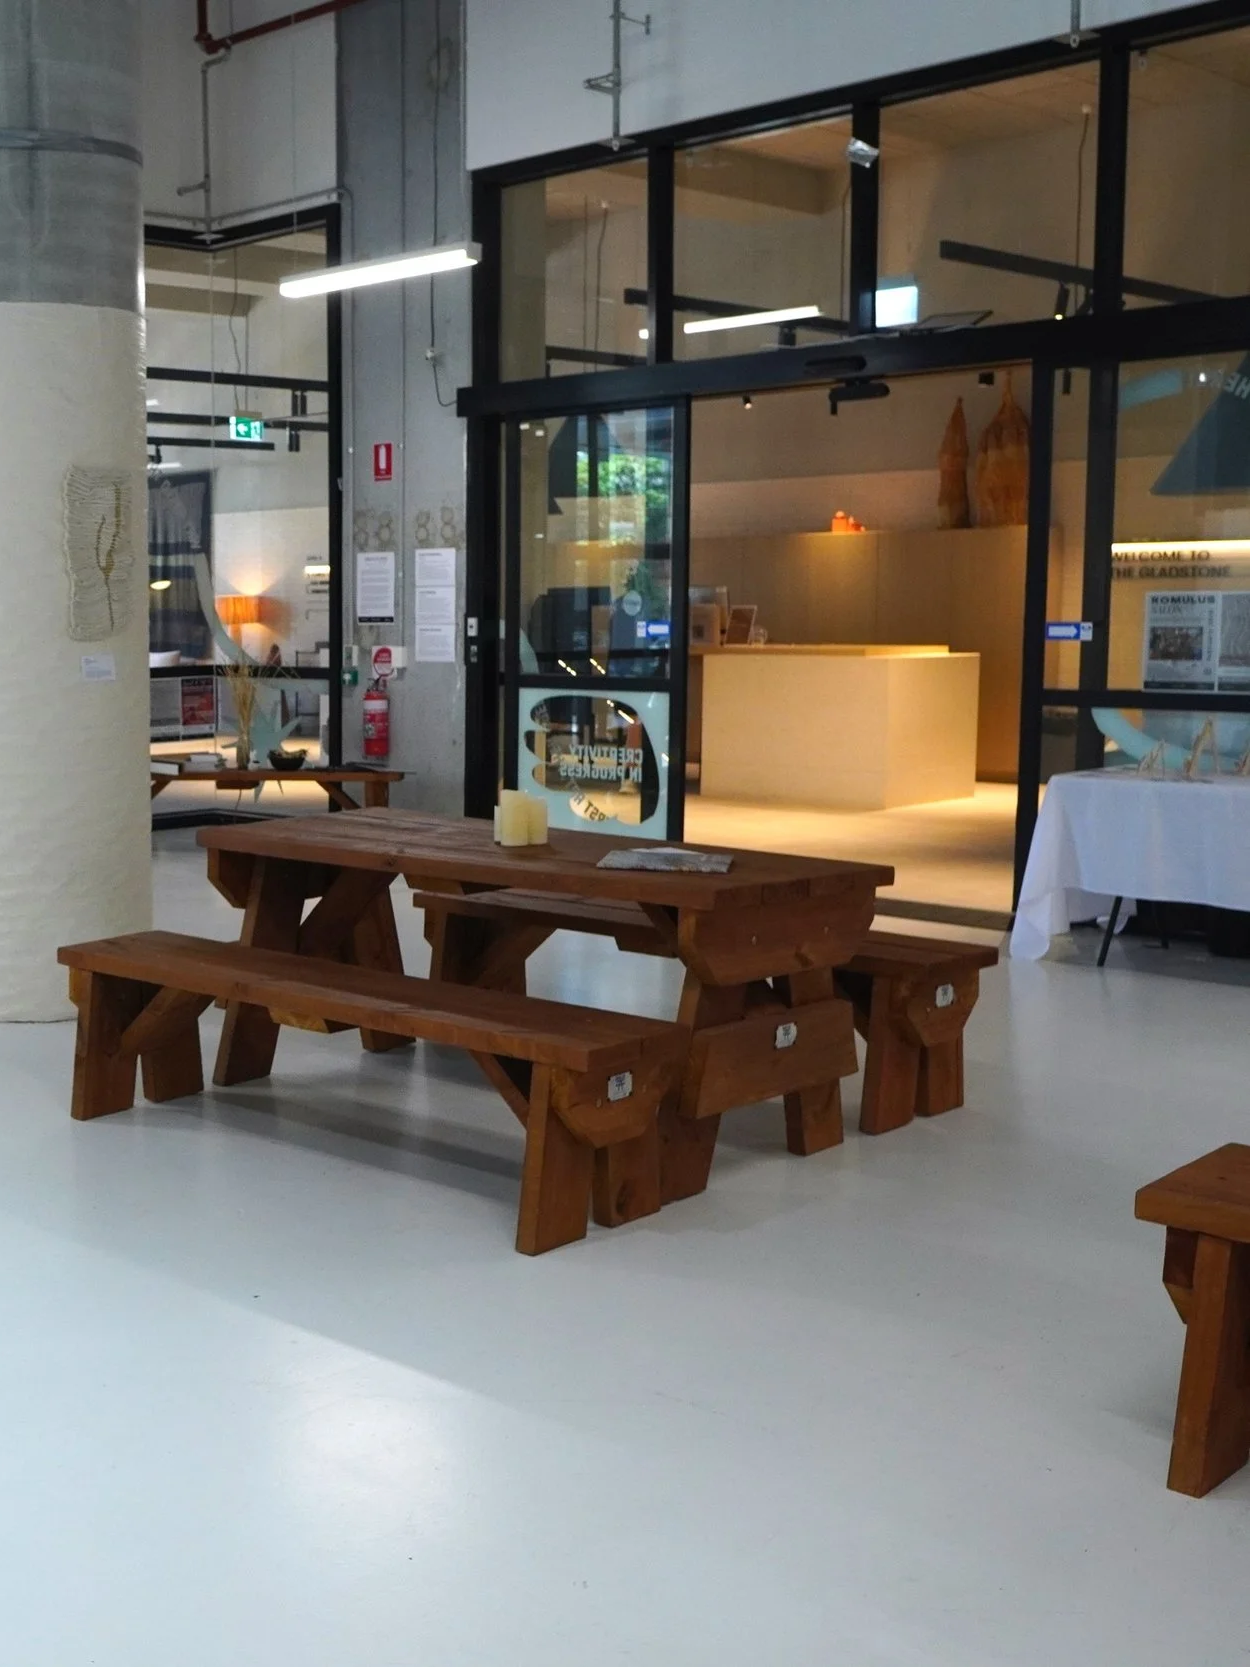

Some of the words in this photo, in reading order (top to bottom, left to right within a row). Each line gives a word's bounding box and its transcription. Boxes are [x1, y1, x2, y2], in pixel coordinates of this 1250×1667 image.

[1191, 550, 1211, 560] TO
[1111, 566, 1134, 579] HE
[1138, 565, 1232, 579] GLADSTONE
[1151, 594, 1216, 604] ROMULUS
